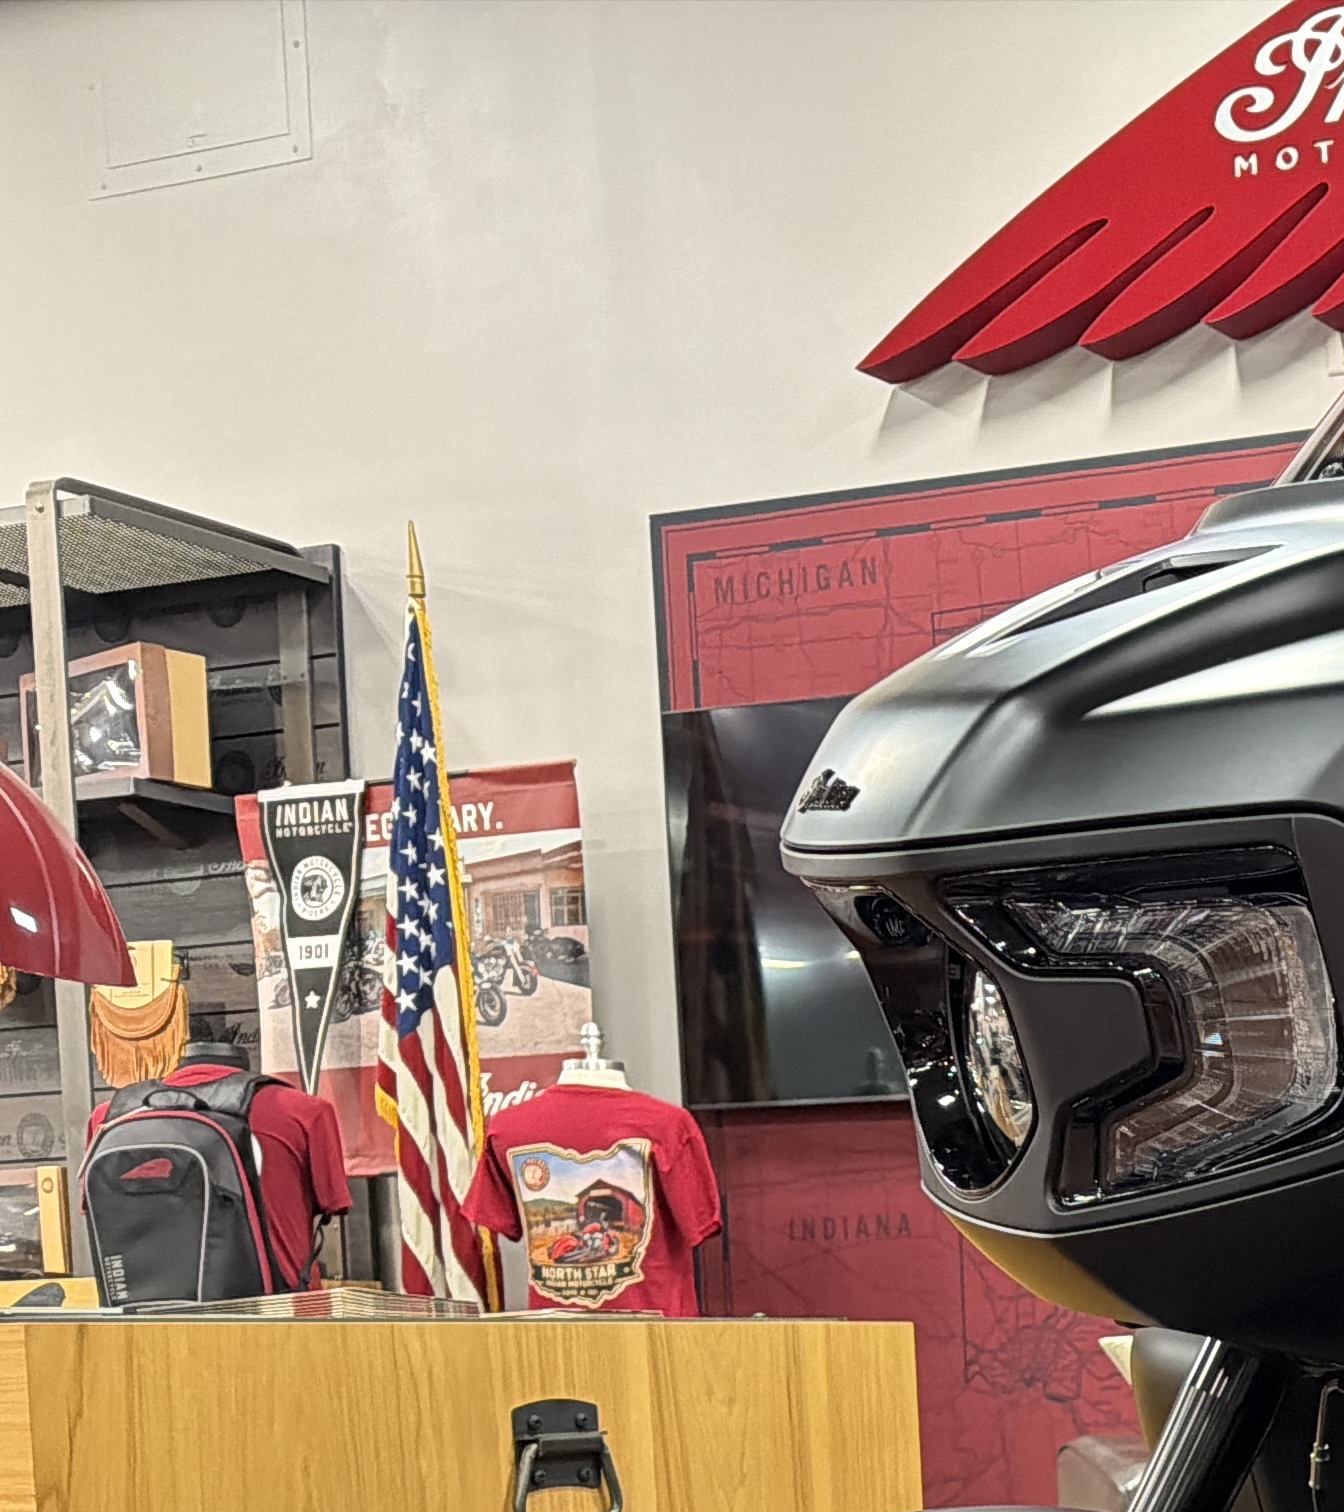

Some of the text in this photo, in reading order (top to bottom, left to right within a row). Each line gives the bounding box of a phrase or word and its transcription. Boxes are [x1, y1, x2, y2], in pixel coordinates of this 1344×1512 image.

[713, 557, 879, 603] MICHIGAN
[275, 797, 349, 827] INDIAN
[275, 822, 351, 839] MOTORCYCLE
[298, 943, 330, 961] 1901
[481, 1073, 545, 1116] Indi
[788, 1212, 913, 1240] INDIANA
[110, 1254, 130, 1301] INDIAN
[541, 1263, 617, 1280] NORTH STAR
